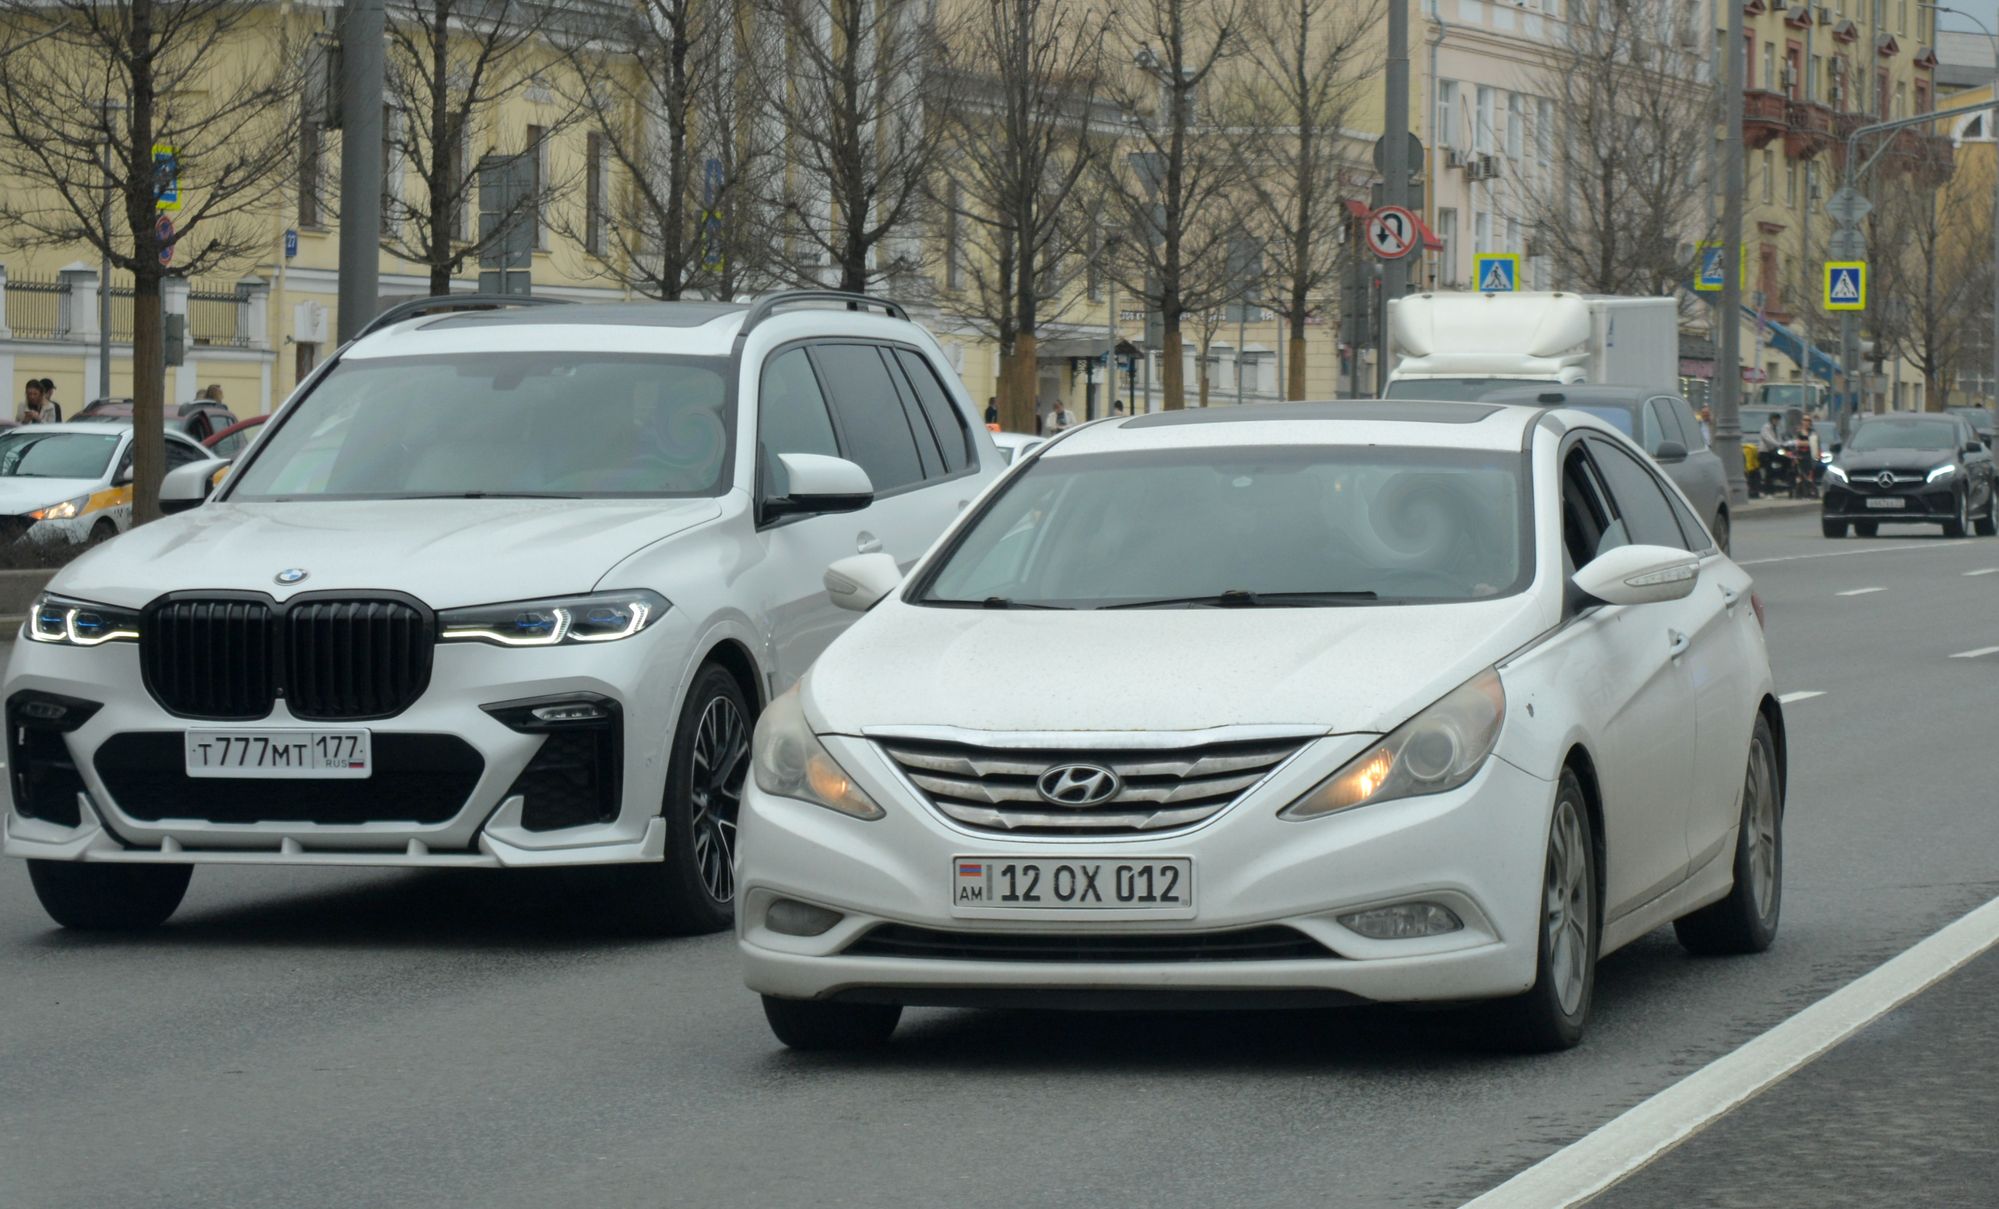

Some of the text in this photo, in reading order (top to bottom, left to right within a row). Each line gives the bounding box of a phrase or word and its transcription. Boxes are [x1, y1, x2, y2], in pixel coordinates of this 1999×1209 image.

[316, 736, 358, 758] 177
[325, 759, 348, 768] RUS
[1001, 864, 1180, 902] 12 OX 012
[959, 886, 982, 901] AM
